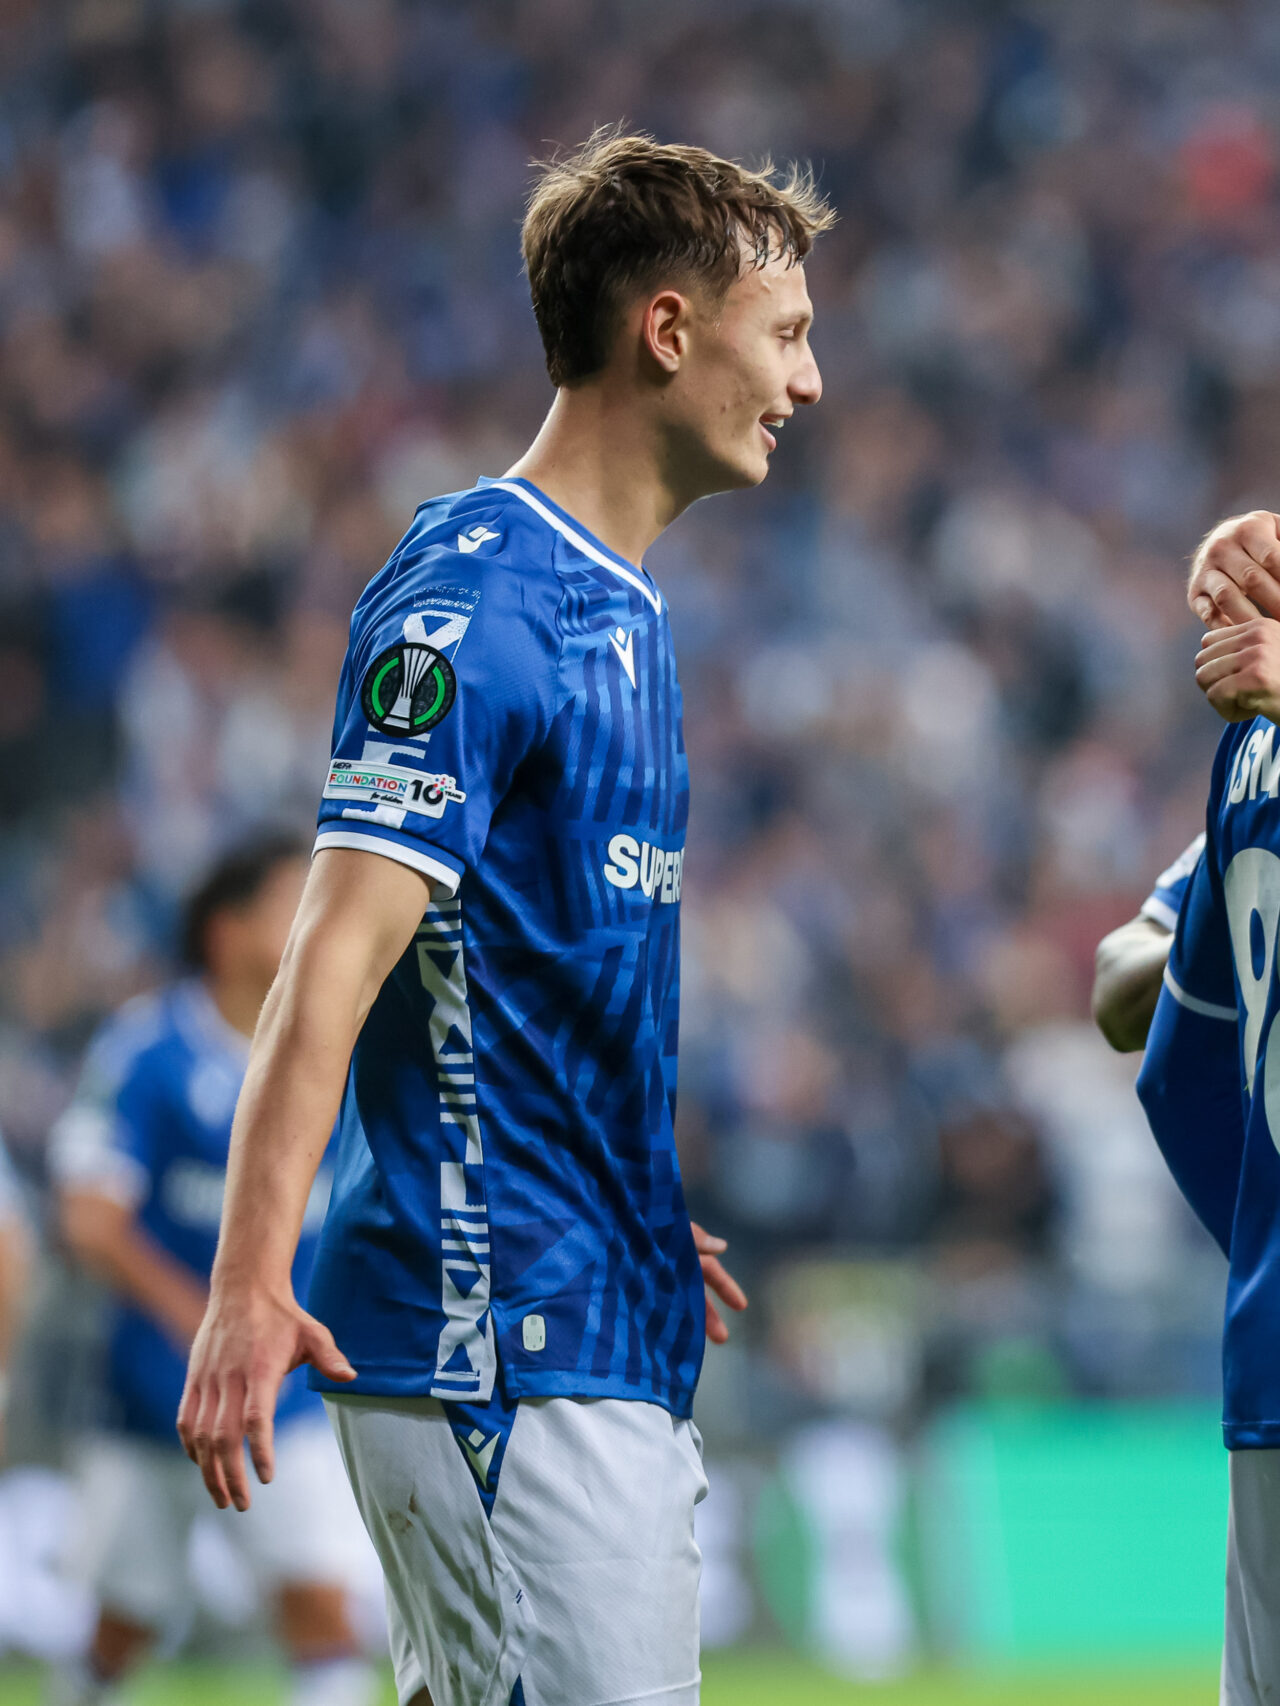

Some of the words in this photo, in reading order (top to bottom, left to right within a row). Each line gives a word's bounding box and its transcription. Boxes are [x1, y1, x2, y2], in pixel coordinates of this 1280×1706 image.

[333, 762, 352, 770] UEFA
[329, 774, 408, 793] FOUNDATION
[410, 779, 444, 805] 10
[604, 833, 685, 904] SUPER
